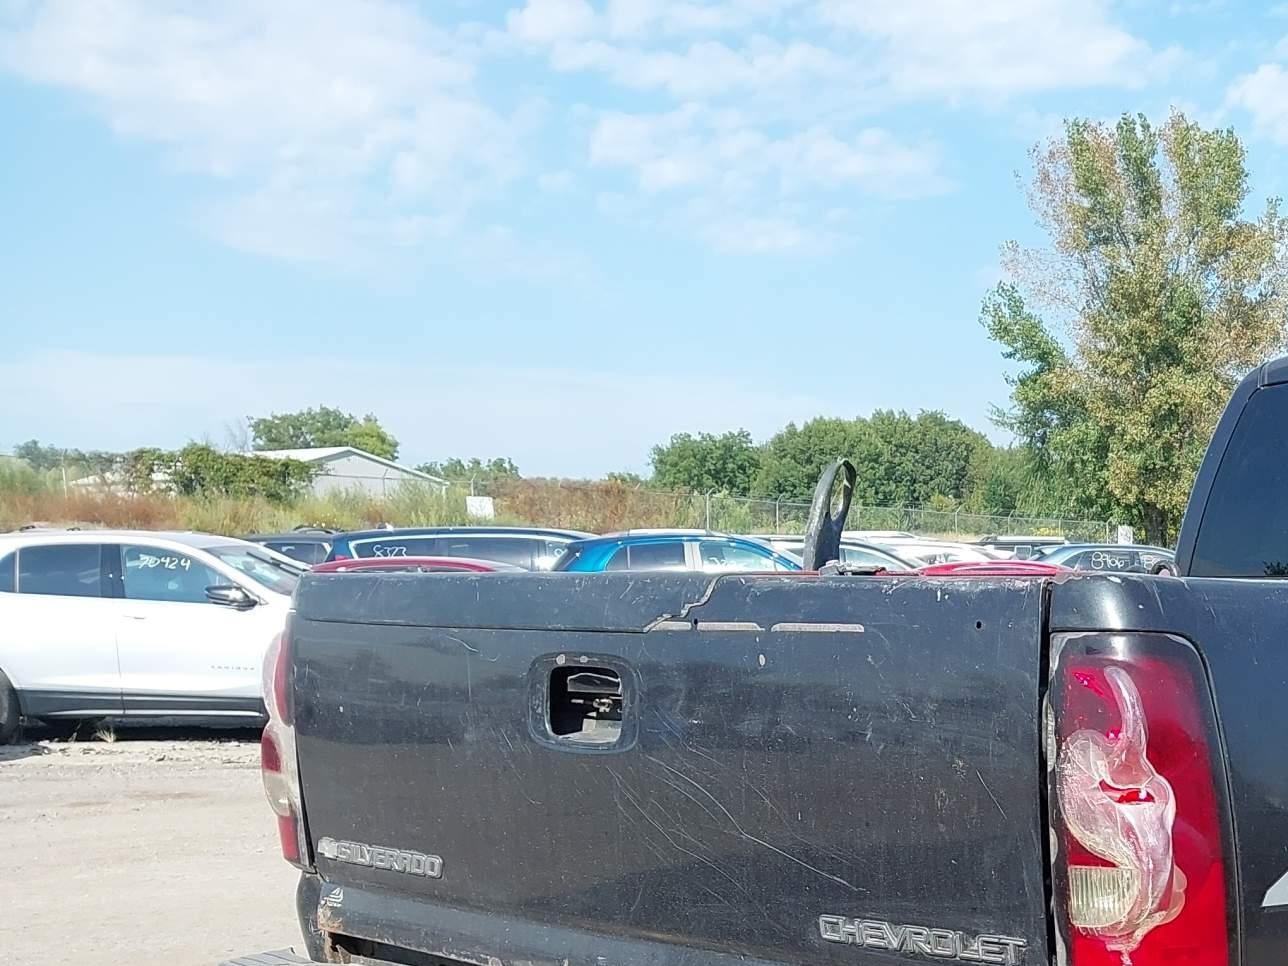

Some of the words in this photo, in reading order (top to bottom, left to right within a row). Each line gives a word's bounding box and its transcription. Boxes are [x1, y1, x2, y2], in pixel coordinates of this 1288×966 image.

[138, 554, 191, 571] 70424
[338, 840, 445, 879] SILVERADO
[819, 914, 1027, 966] CHEVROLET
